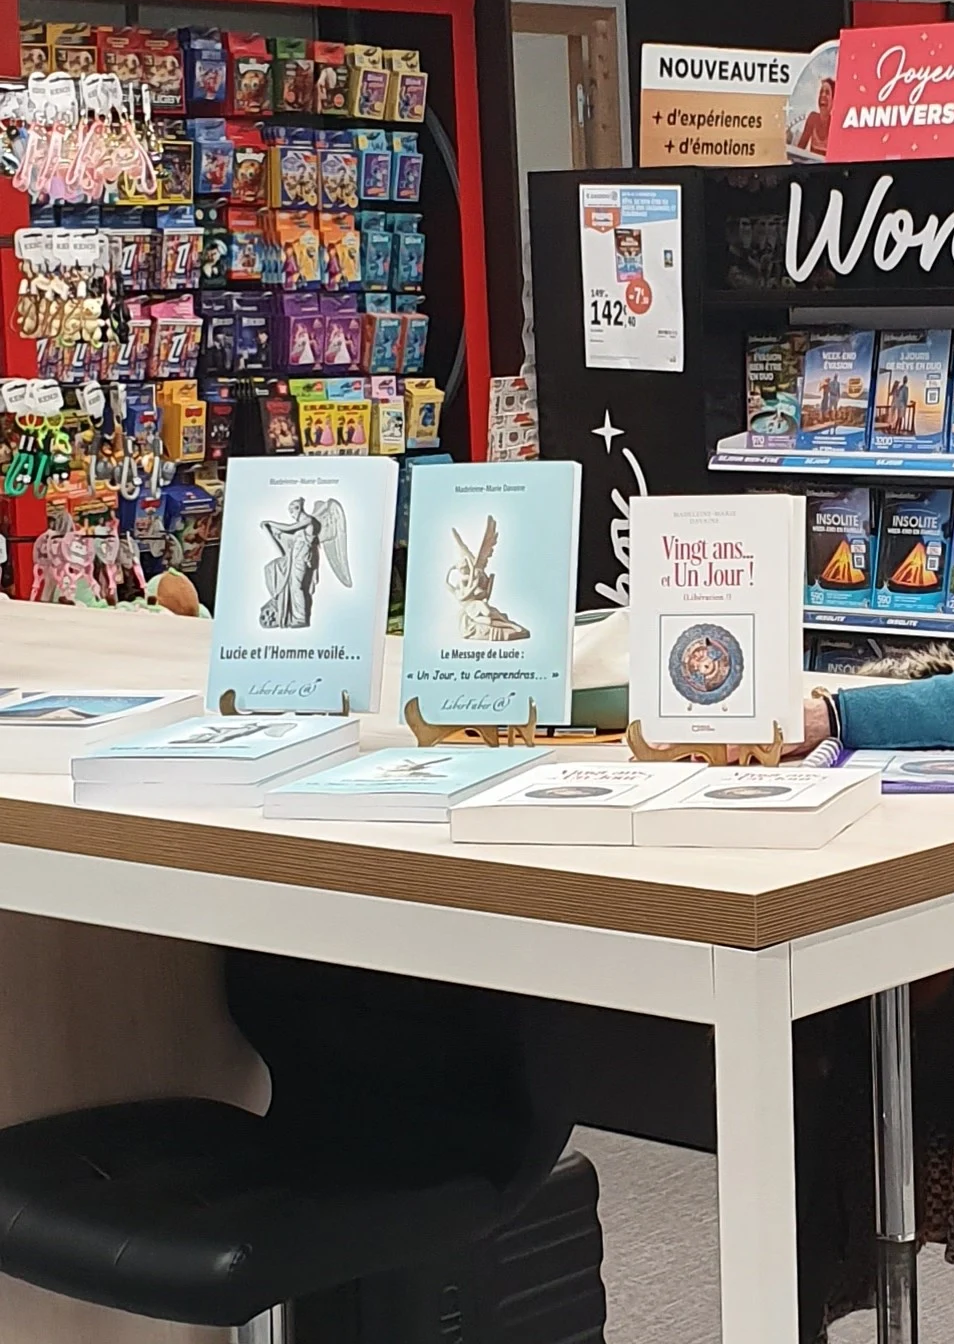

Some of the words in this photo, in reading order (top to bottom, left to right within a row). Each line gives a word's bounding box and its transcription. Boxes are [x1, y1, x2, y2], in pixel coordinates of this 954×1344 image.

[659, 57, 790, 83] NOUVEAUTÉS
[667, 108, 762, 130] d'expériences
[679, 138, 755, 156] d'émotions
[816, 513, 860, 528] INSOLITE
[892, 515, 938, 529] INSOLITE
[662, 536, 709, 566] Vingt
[712, 541, 754, 559] ans...
[661, 575, 671, 588] et
[674, 562, 699, 588] Un
[703, 562, 745, 587] Jour
[749, 561, 754, 587] !
[220, 646, 248, 661] Lucie
[249, 647, 262, 661] et
[264, 646, 316, 661] l'Homme
[317, 646, 361, 661] voilé...
[441, 649, 450, 660] Le
[451, 649, 486, 663] Message
[487, 648, 498, 660] de
[499, 648, 520, 660] Lucie
[417, 671, 430, 680] Un
[432, 670, 457, 682] Jour,
[460, 671, 471, 680] tu
[473, 670, 548, 683] Comprendras...
